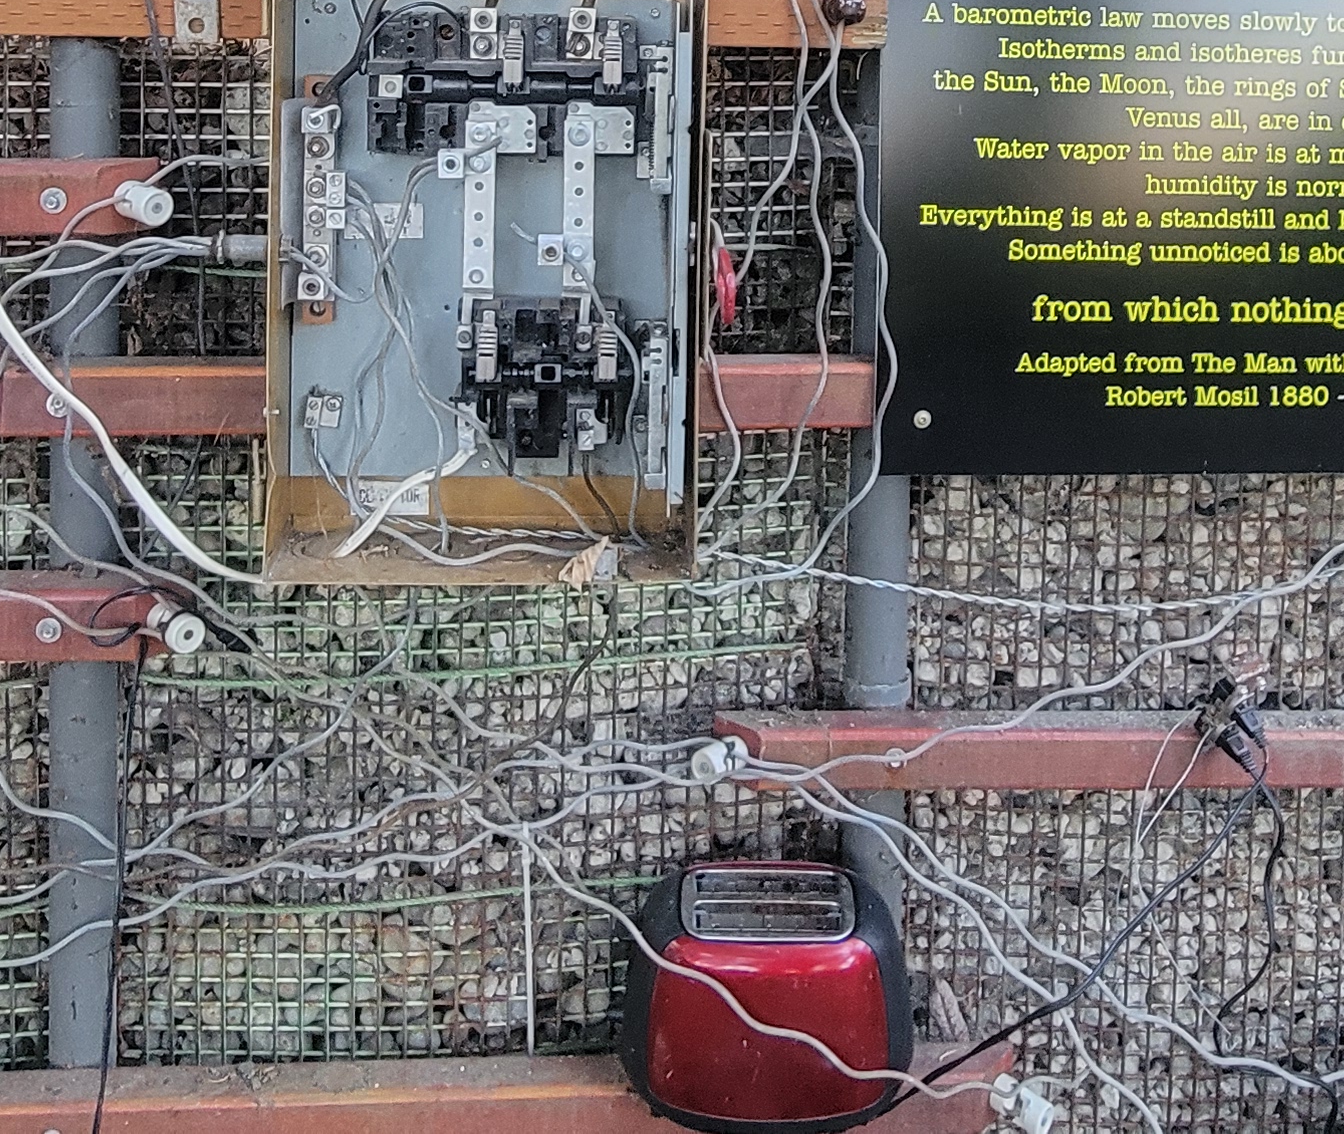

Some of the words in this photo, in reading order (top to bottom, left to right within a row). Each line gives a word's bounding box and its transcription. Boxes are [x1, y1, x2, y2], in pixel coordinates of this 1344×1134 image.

[921, 2, 944, 23] A
[951, 2, 1092, 27] barometric
[1099, 6, 1144, 28] law
[1151, 12, 1230, 30] moves
[1239, 10, 1319, 37] slowly
[998, 37, 1126, 61] Isotherms
[1134, 41, 1182, 62] and
[1189, 42, 1302, 65] isotheres
[932, 69, 975, 91] the
[983, 70, 1039, 97] Sun,
[1049, 72, 1091, 94] the
[1098, 73, 1175, 100] Moon,
[1184, 75, 1225, 96] the
[1233, 77, 1297, 102] rings
[1306, 78, 1331, 98] of
[1124, 106, 1201, 129] Venus
[1210, 108, 1248, 134] all,
[1258, 114, 1299, 131] are
[1308, 111, 1333, 131] in
[973, 137, 1050, 160] Water
[1057, 143, 1131, 165] vapor
[1138, 141, 1165, 161] in
[1172, 141, 1213, 162] the
[1221, 142, 1258, 163] air
[1265, 143, 1287, 164] is
[1295, 144, 1321, 164] at
[1144, 173, 1259, 201] humidity
[1266, 176, 1288, 197] is
[919, 204, 1064, 232] Everything
[1070, 206, 1093, 228] is
[1101, 207, 1128, 228] at
[1135, 211, 1152, 228] a
[1160, 207, 1276, 230] standstill
[1283, 209, 1331, 231] and
[1008, 238, 1143, 266] Something
[1148, 241, 1272, 263] unnoticed
[1278, 242, 1301, 264] is
[1031, 294, 1114, 322] from
[1123, 295, 1221, 323] which
[1014, 352, 1117, 377] Adapted
[1123, 352, 1185, 373] from
[1191, 352, 1237, 374] The
[1243, 352, 1298, 374] Man
[1104, 385, 1188, 407] Robert
[1193, 385, 1260, 407] Mosil
[1269, 385, 1330, 407] 1880
